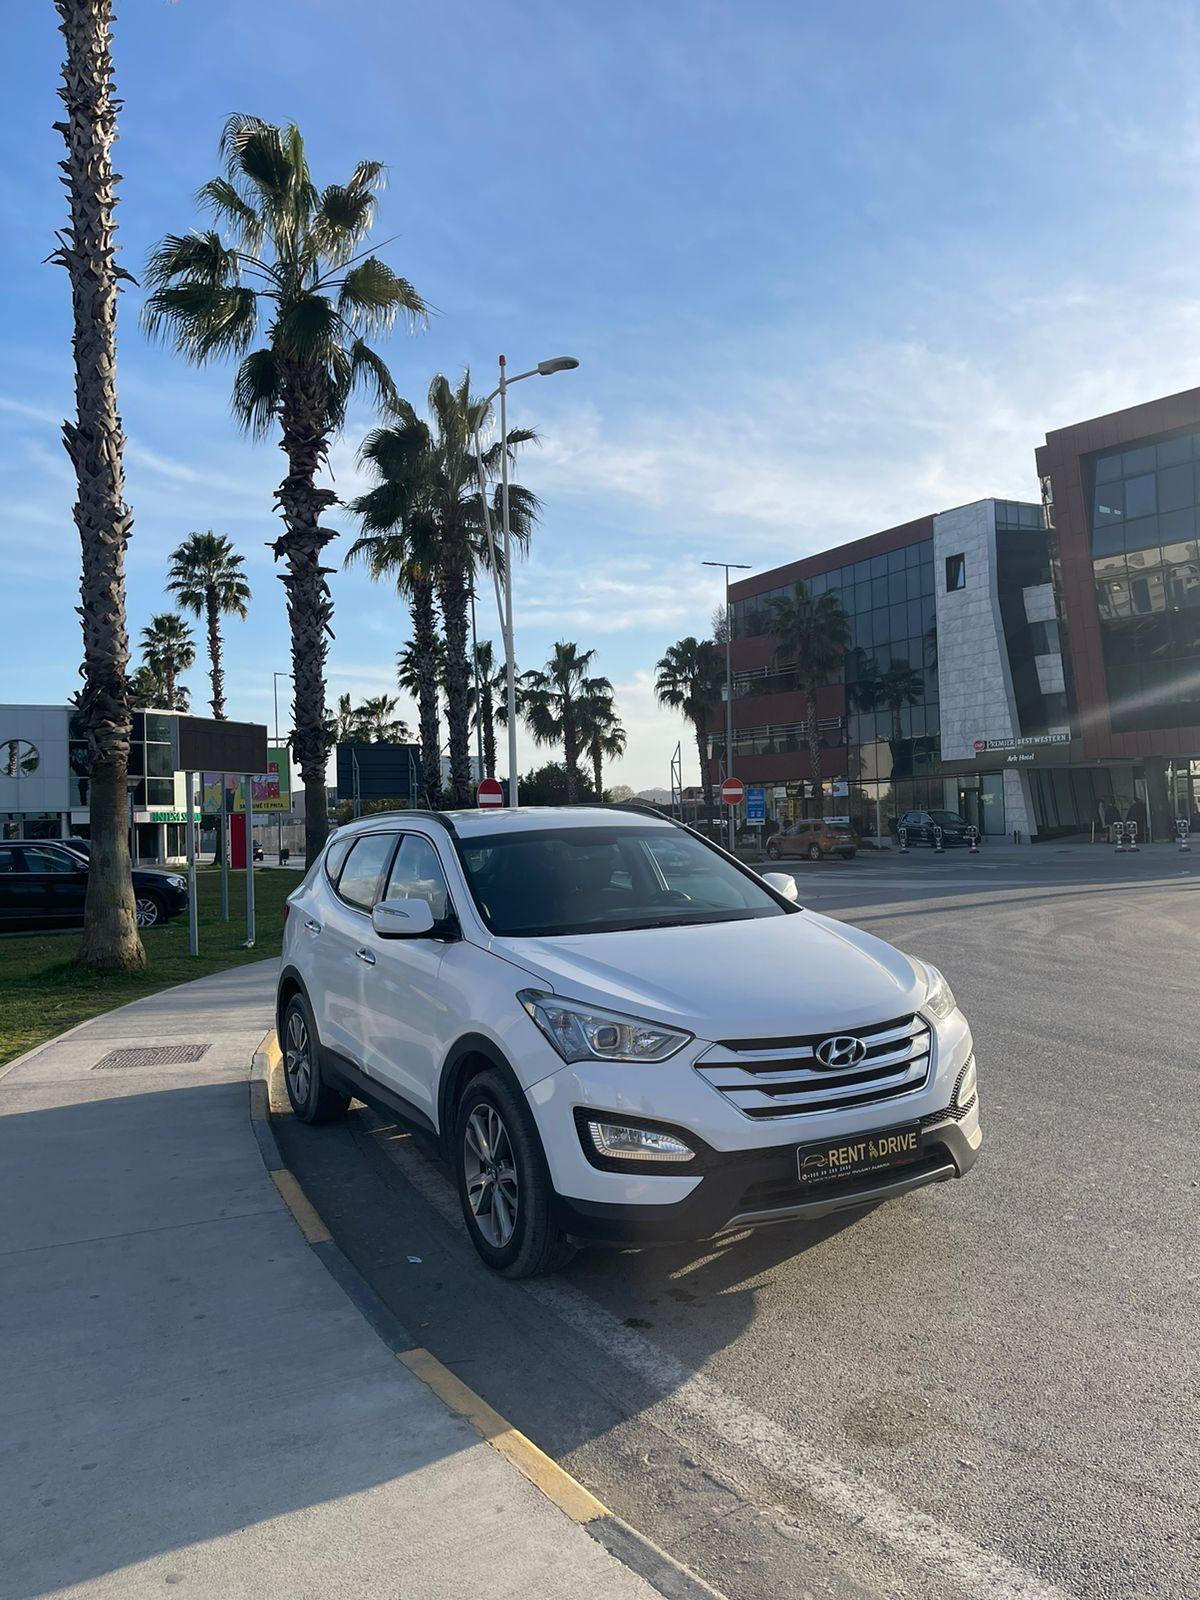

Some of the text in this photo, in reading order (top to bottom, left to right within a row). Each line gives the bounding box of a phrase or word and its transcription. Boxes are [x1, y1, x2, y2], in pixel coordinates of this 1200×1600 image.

[986, 739, 1015, 749] PREMIER
[1034, 735, 1067, 743] WESTERN
[1019, 753, 1035, 761] Hotel
[828, 1143, 867, 1167] RENT
[878, 1132, 918, 1156] DRIVE
